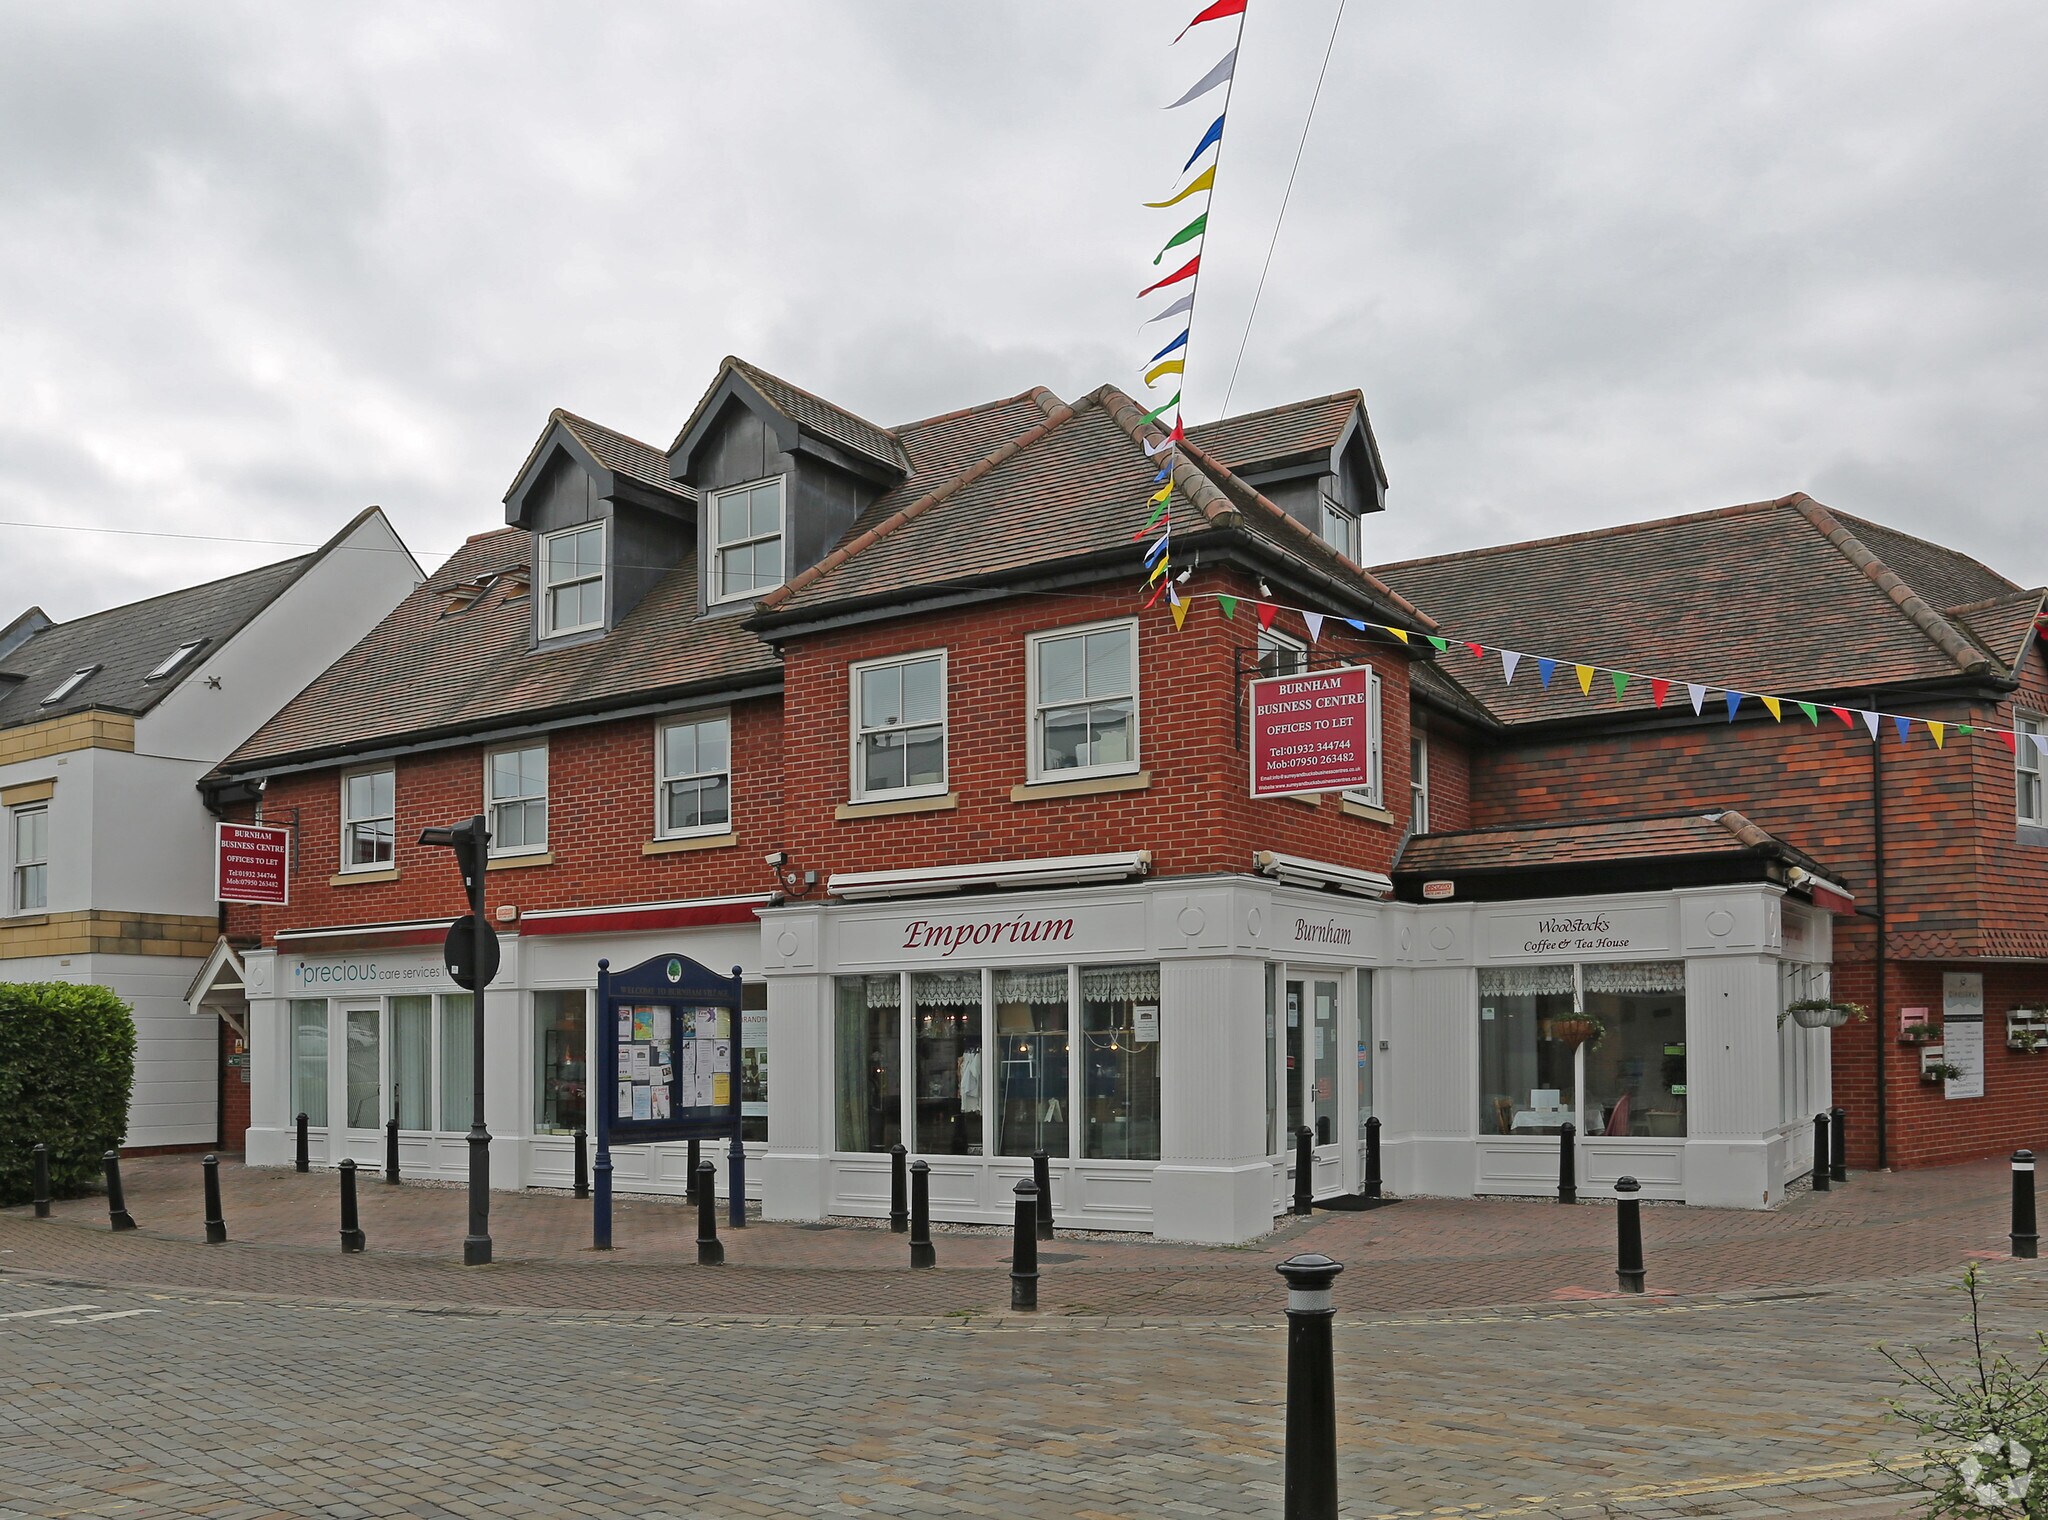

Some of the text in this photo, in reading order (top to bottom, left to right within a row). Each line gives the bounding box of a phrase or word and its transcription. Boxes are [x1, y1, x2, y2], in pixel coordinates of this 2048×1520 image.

[1279, 678, 1341, 695] BURNHAM
[1257, 693, 1365, 716] BUSINESS CENTRE
[1267, 717, 1354, 736] OFFICES TO LET
[1270, 740, 1351, 757] Tel:01932 344744
[1267, 752, 1354, 771] Mob:07950 263482
[234, 830, 272, 840] BURNHAM
[221, 840, 285, 853] BUSINESS CENTRE
[226, 855, 254, 863] OFFICES
[902, 913, 1075, 957] Emporium
[1294, 918, 1352, 945] Burnham
[1524, 937, 1630, 953] Coffee & Tea House
[303, 960, 377, 988] precious
[379, 969, 401, 980] care
[402, 965, 440, 979] services
